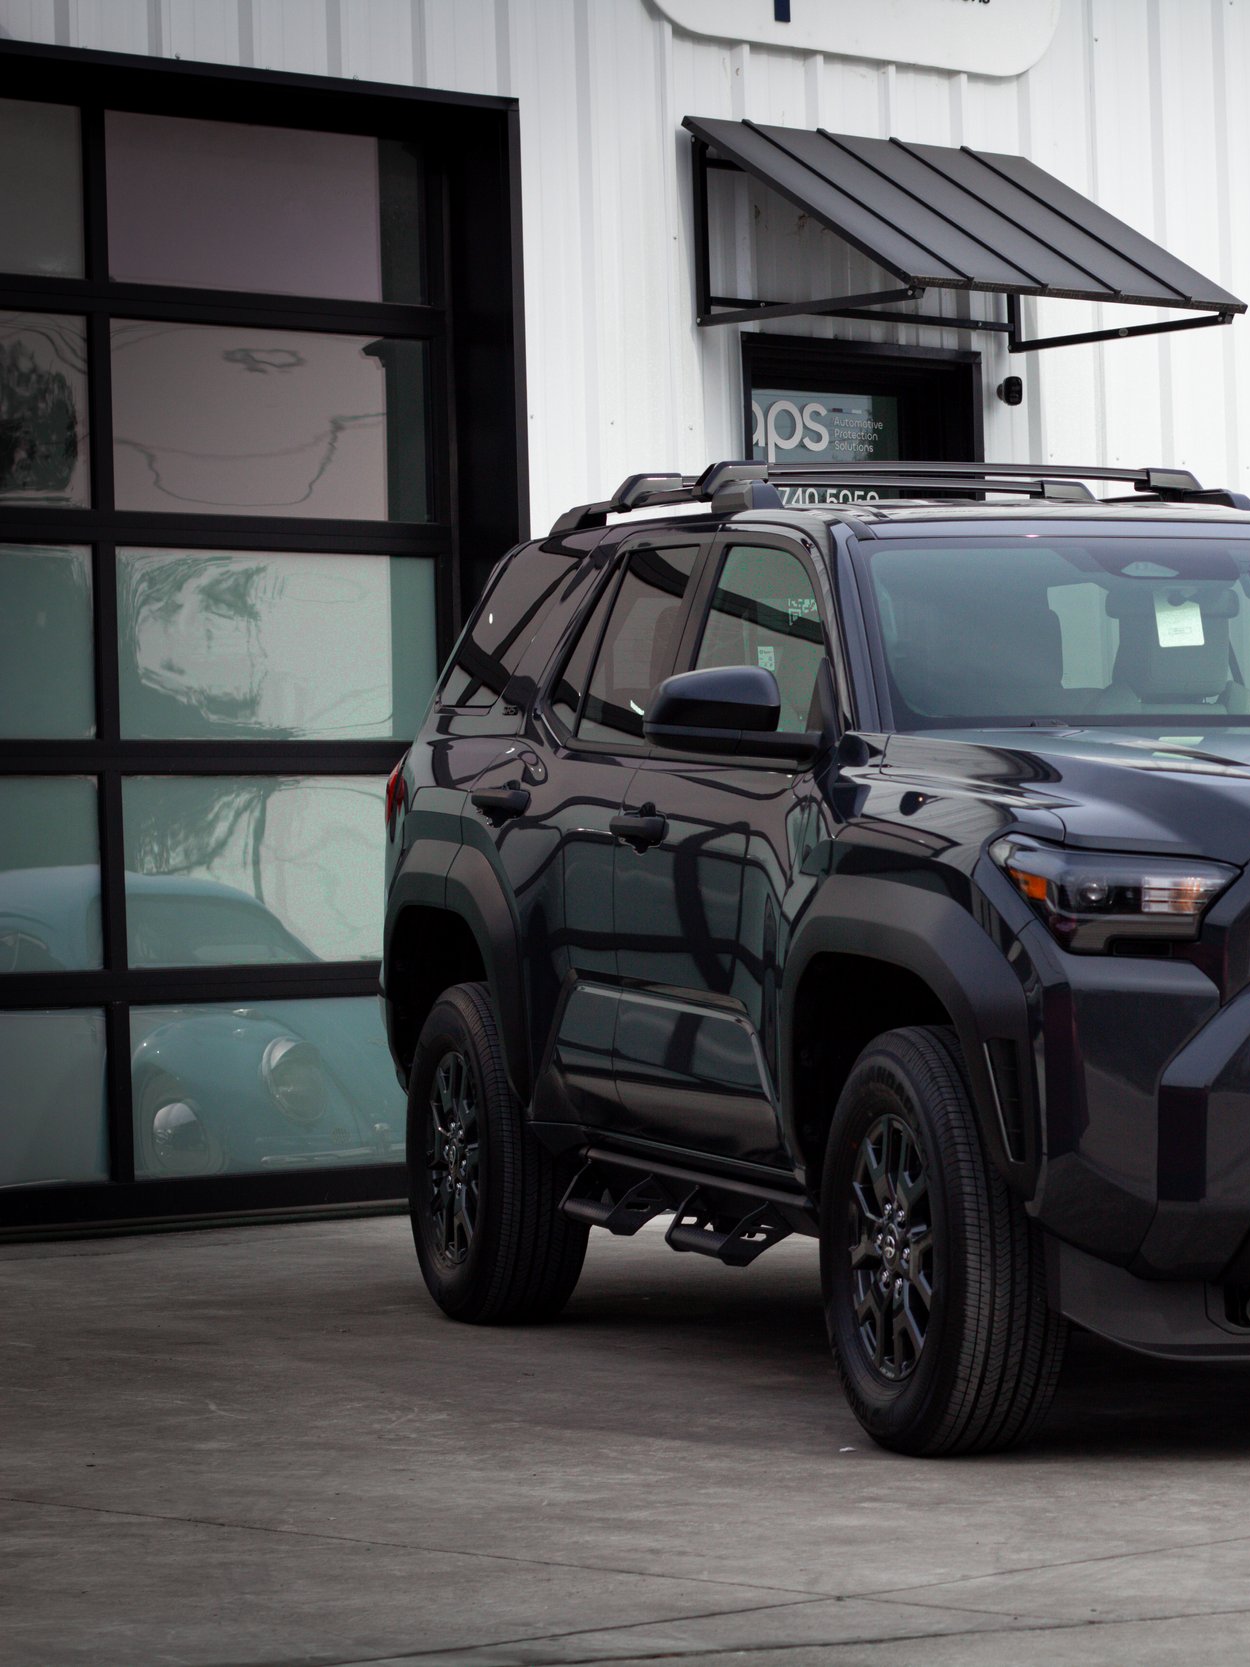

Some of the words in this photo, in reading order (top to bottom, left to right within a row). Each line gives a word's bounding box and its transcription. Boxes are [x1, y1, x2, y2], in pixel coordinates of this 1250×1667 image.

[833, 417, 883, 430] Automotive
[834, 428, 878, 441] Protection
[834, 441, 874, 453] Solutions
